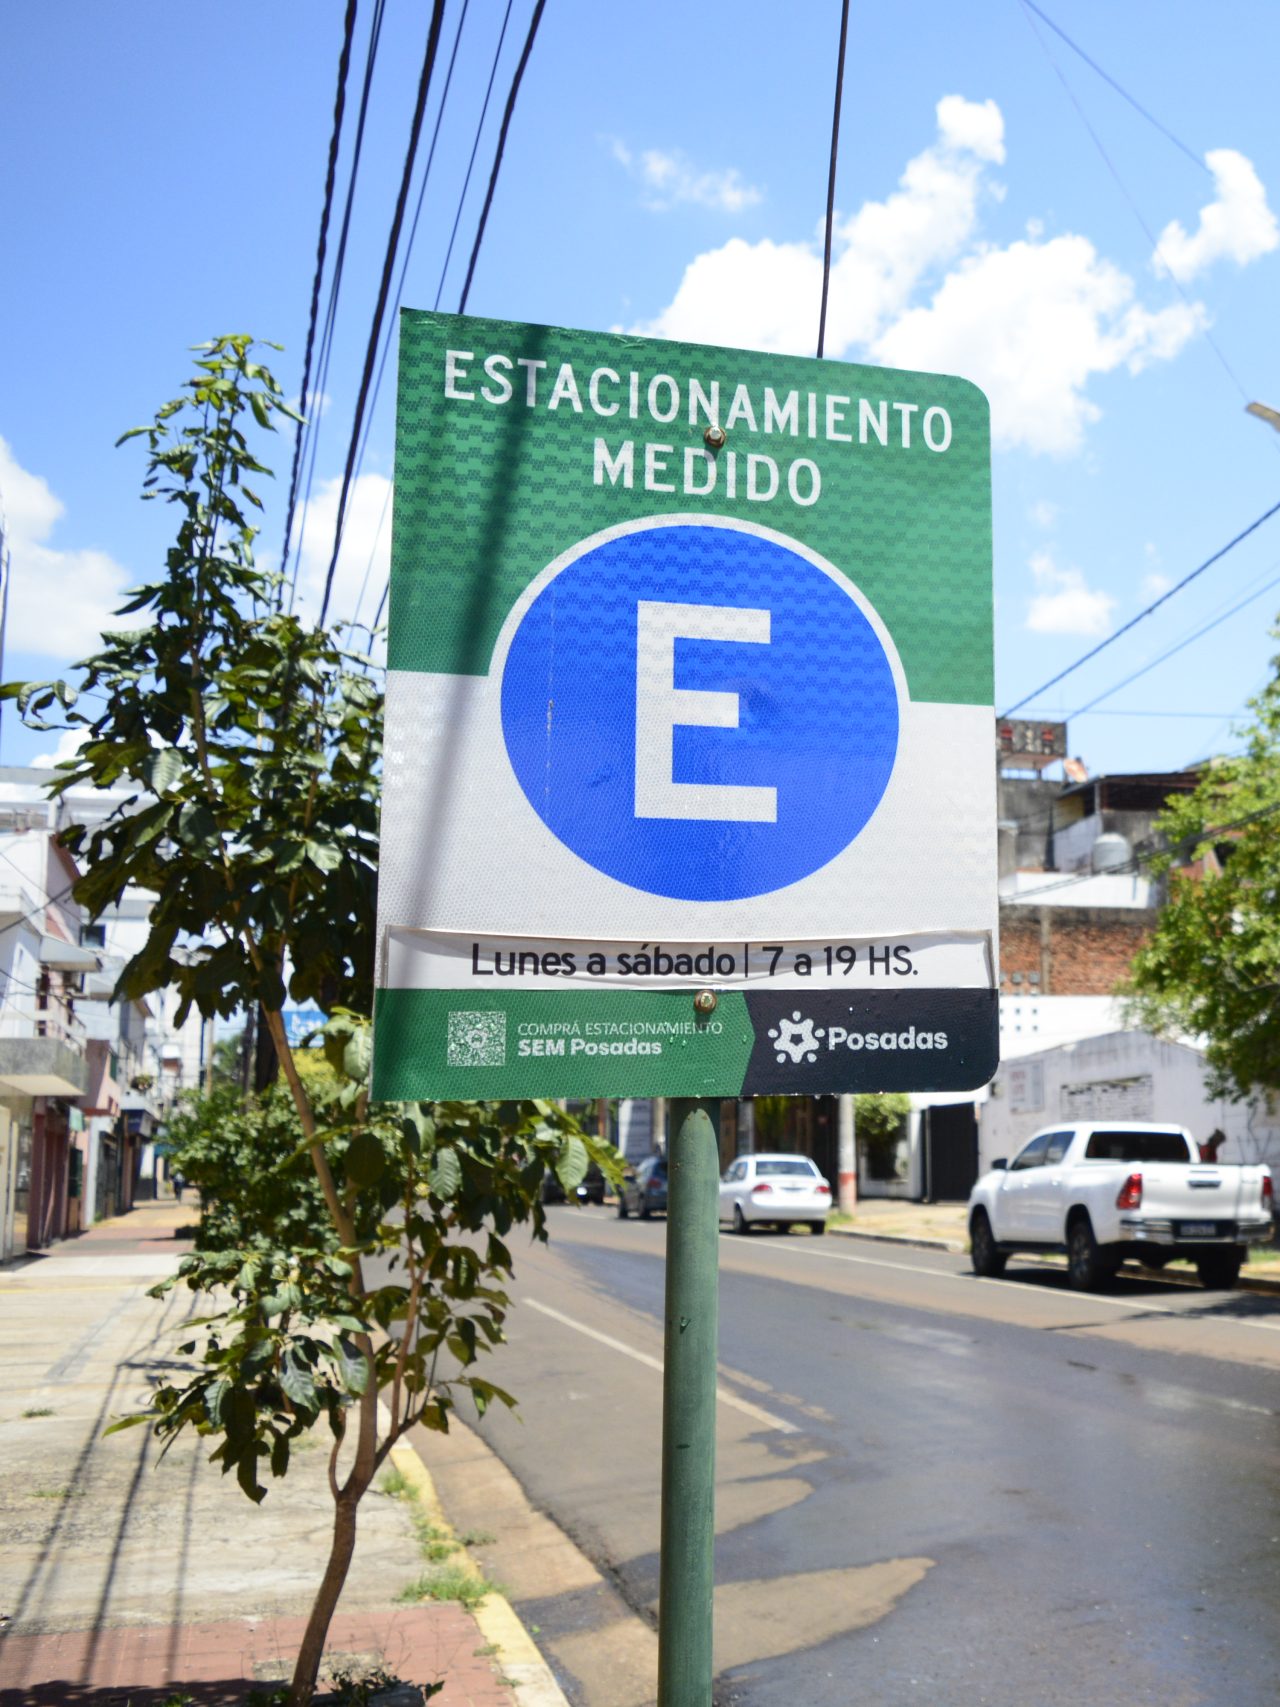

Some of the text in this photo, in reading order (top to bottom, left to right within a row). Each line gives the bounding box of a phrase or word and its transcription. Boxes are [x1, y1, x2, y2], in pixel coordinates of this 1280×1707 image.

[444, 349, 952, 452] ESTACIONAMIENTO
[592, 436, 821, 506] MEDIDO
[634, 599, 778, 823] E
[471, 942, 919, 977] Lunes a sábado 7 a 19 HS.
[517, 1019, 723, 1036] COMPRÁ ESTACIONAMIENTO
[828, 1025, 949, 1051] Posadas
[517, 1036, 663, 1057] SEM Posadas
